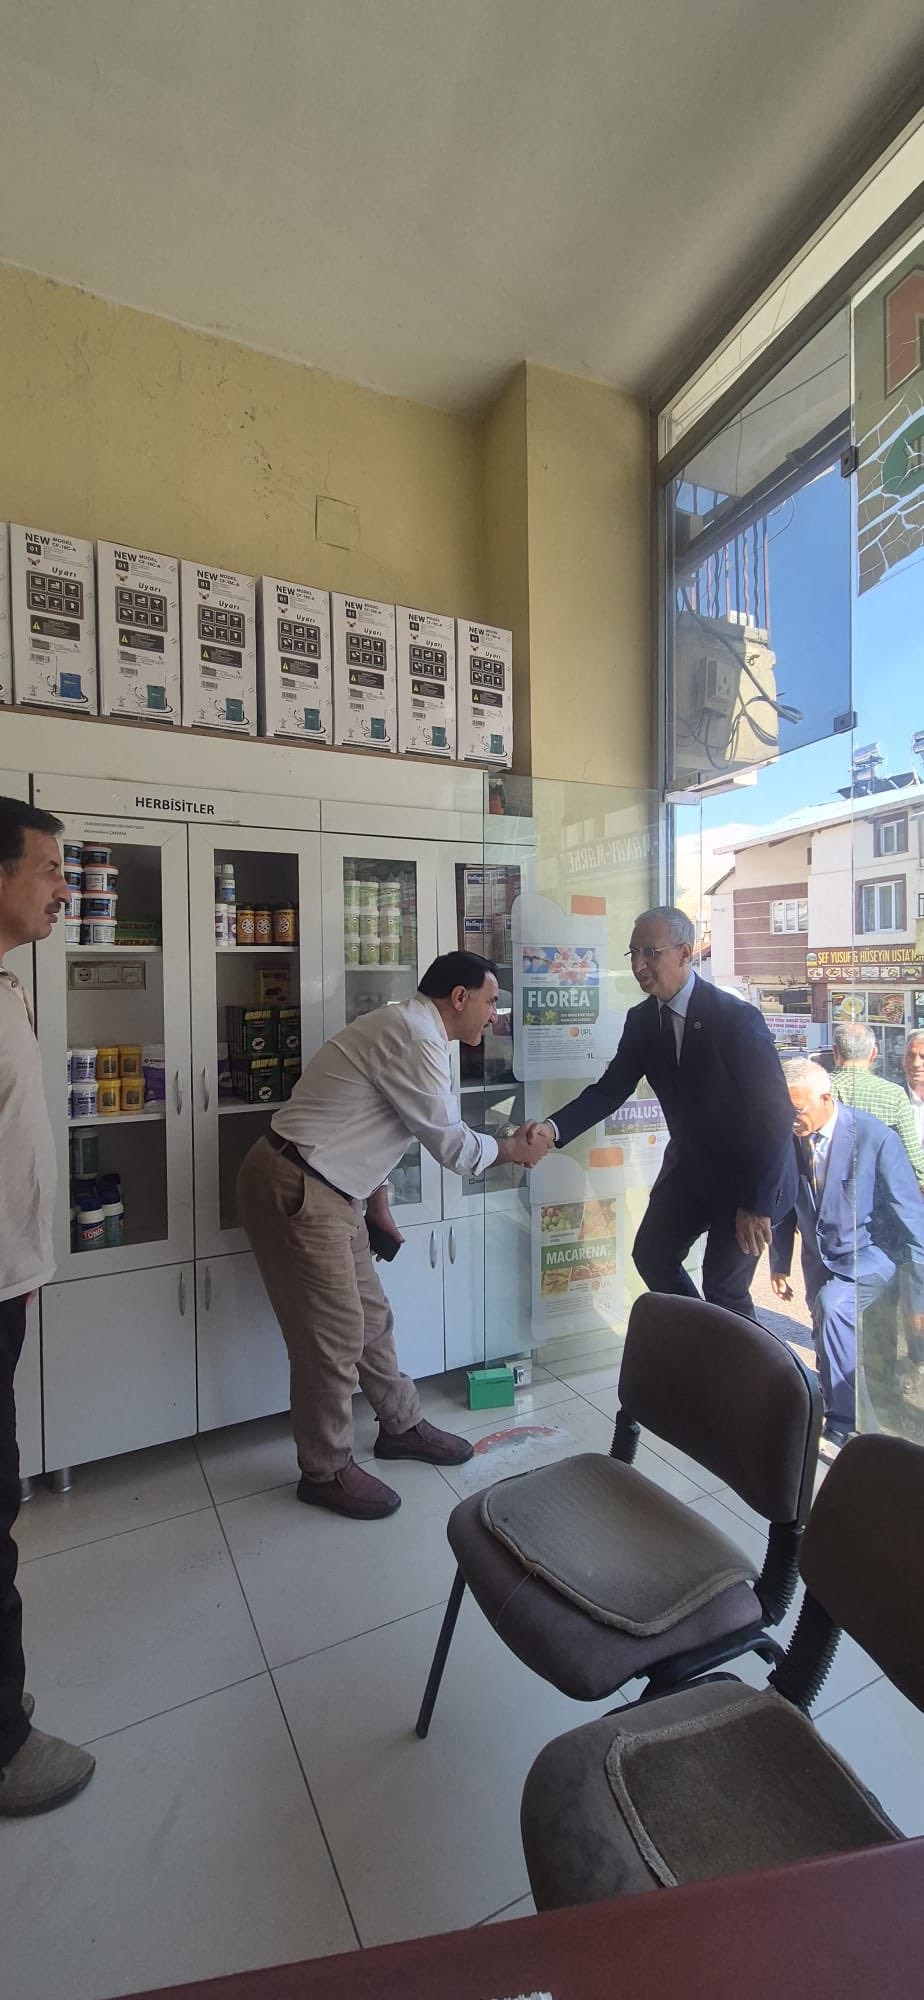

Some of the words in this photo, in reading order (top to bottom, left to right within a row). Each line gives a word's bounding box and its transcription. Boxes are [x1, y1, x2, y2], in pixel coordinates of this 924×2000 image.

[25, 533, 50, 546] NEW
[52, 537, 73, 547] MODEL
[114, 550, 137, 562] NEW
[52, 567, 77, 578] Uyarı
[197, 569, 218, 581] NEW
[138, 583, 161, 592] Uyarı
[276, 585, 294, 596] NEW
[219, 600, 240, 610] Uyarı
[345, 600, 363, 611] NEW
[408, 614, 425, 623] NEW
[469, 626, 484, 635] NEW
[135, 796, 215, 815] HERBİSİTLER
[831, 951, 851, 964] YUSUF
[546, 1243, 608, 1265] MACARENA
